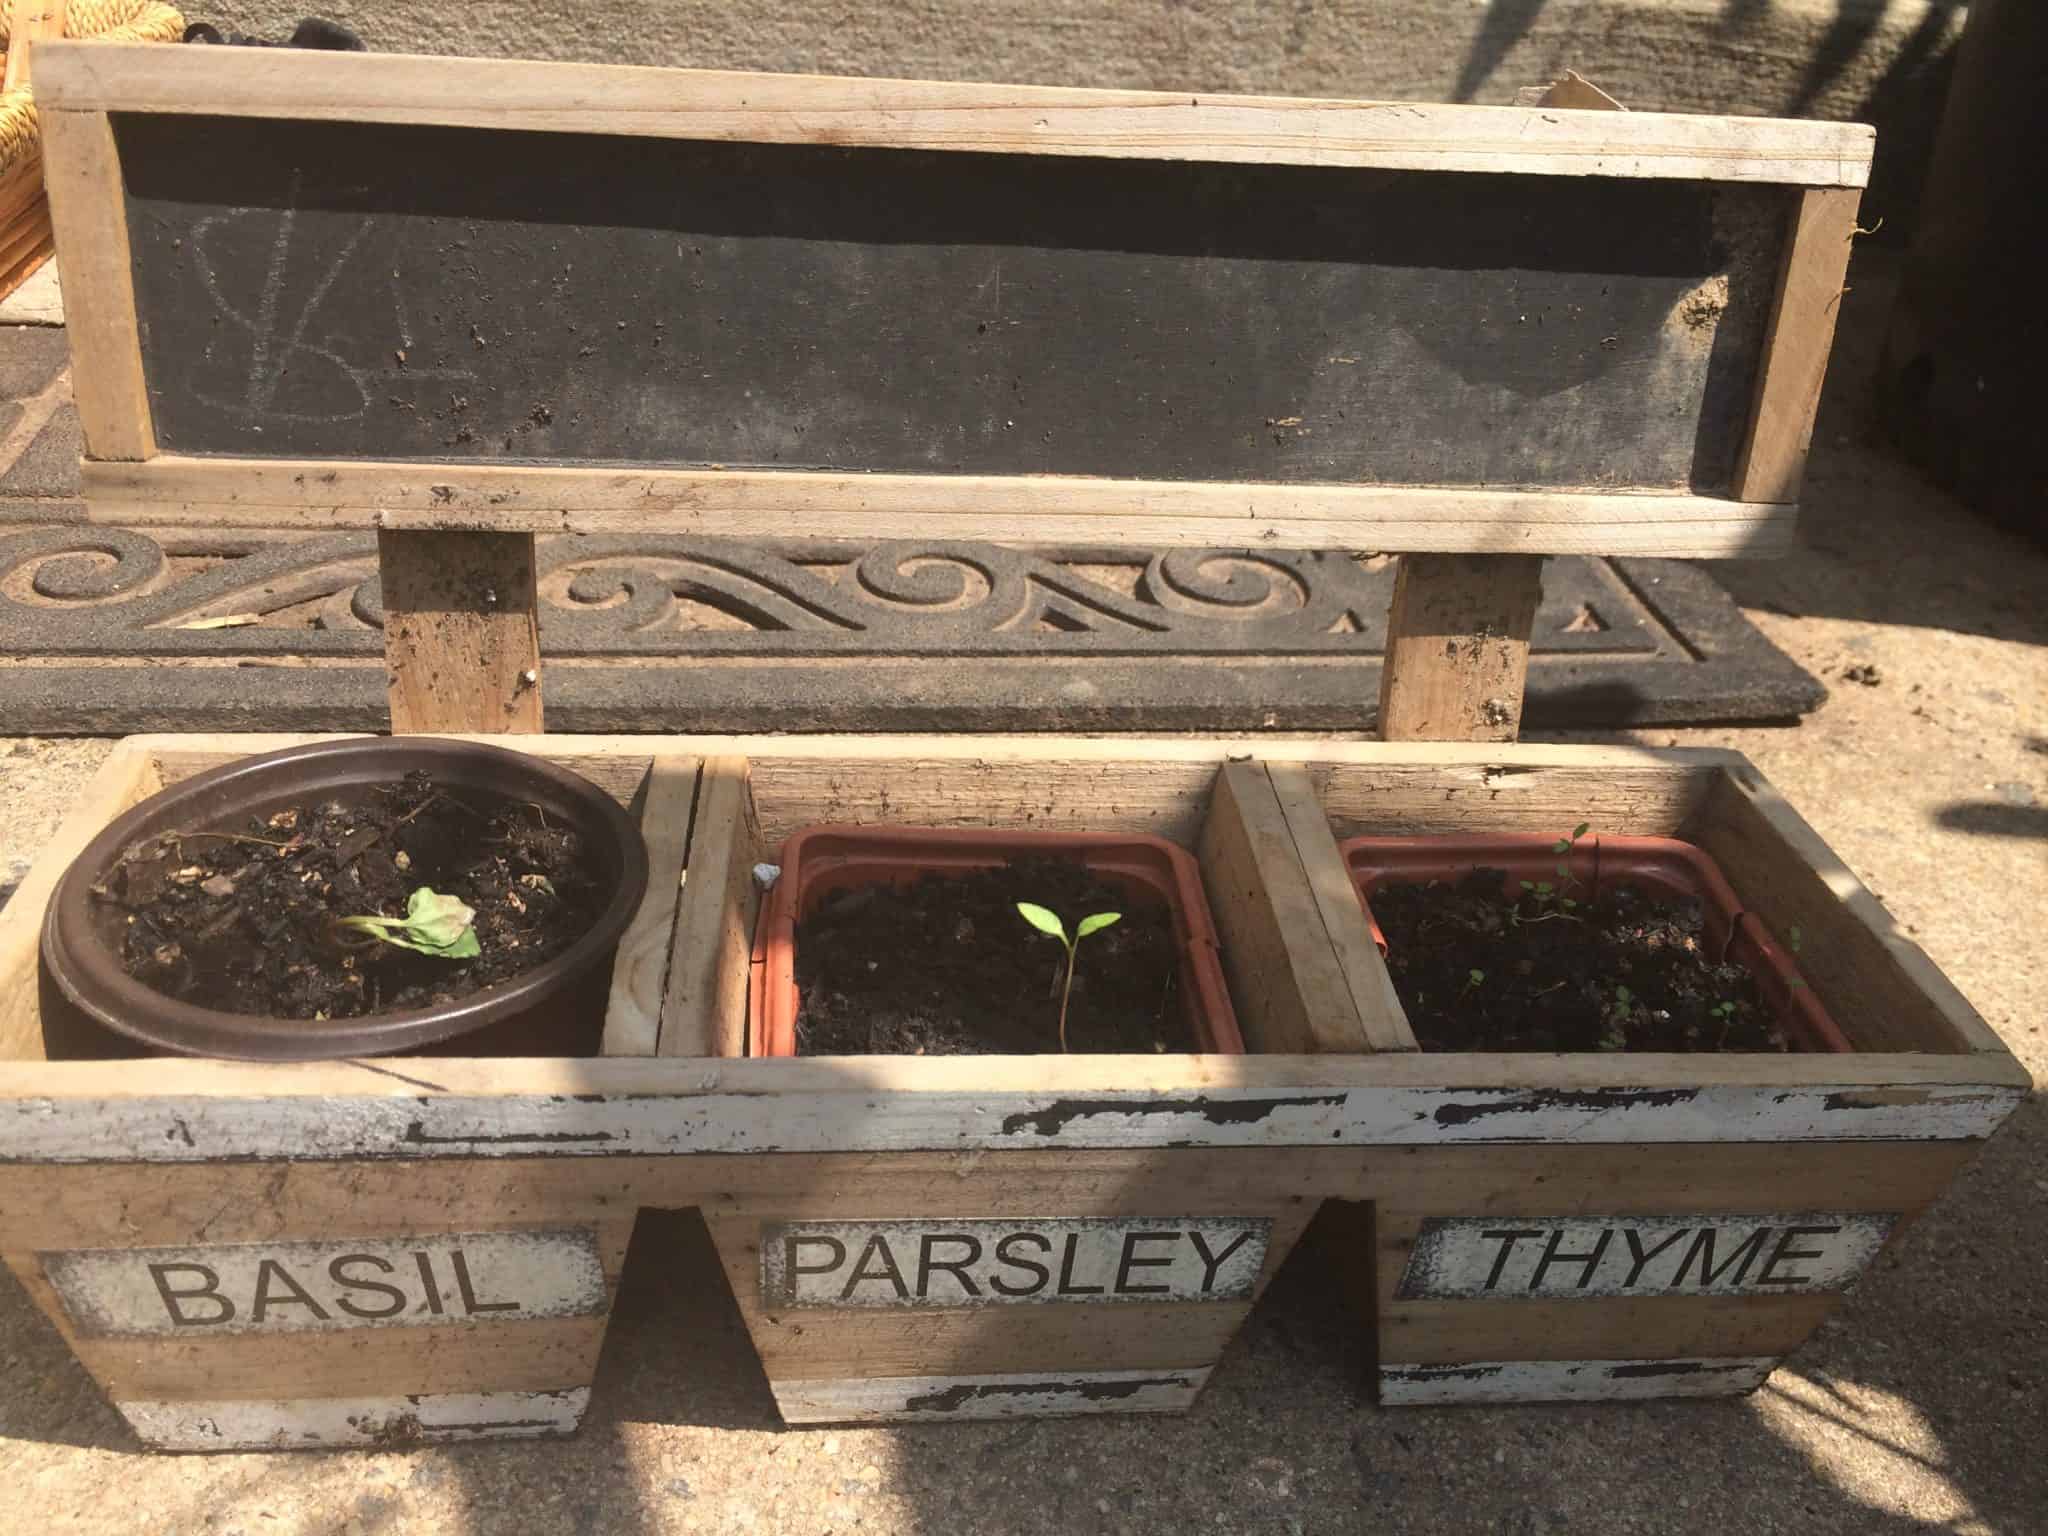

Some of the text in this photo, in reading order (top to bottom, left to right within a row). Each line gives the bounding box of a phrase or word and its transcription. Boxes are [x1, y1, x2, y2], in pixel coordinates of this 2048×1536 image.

[148, 1250, 520, 1326] BASIL
[785, 1230, 1254, 1299] PARSLEY
[1481, 1226, 1841, 1290] THYME
